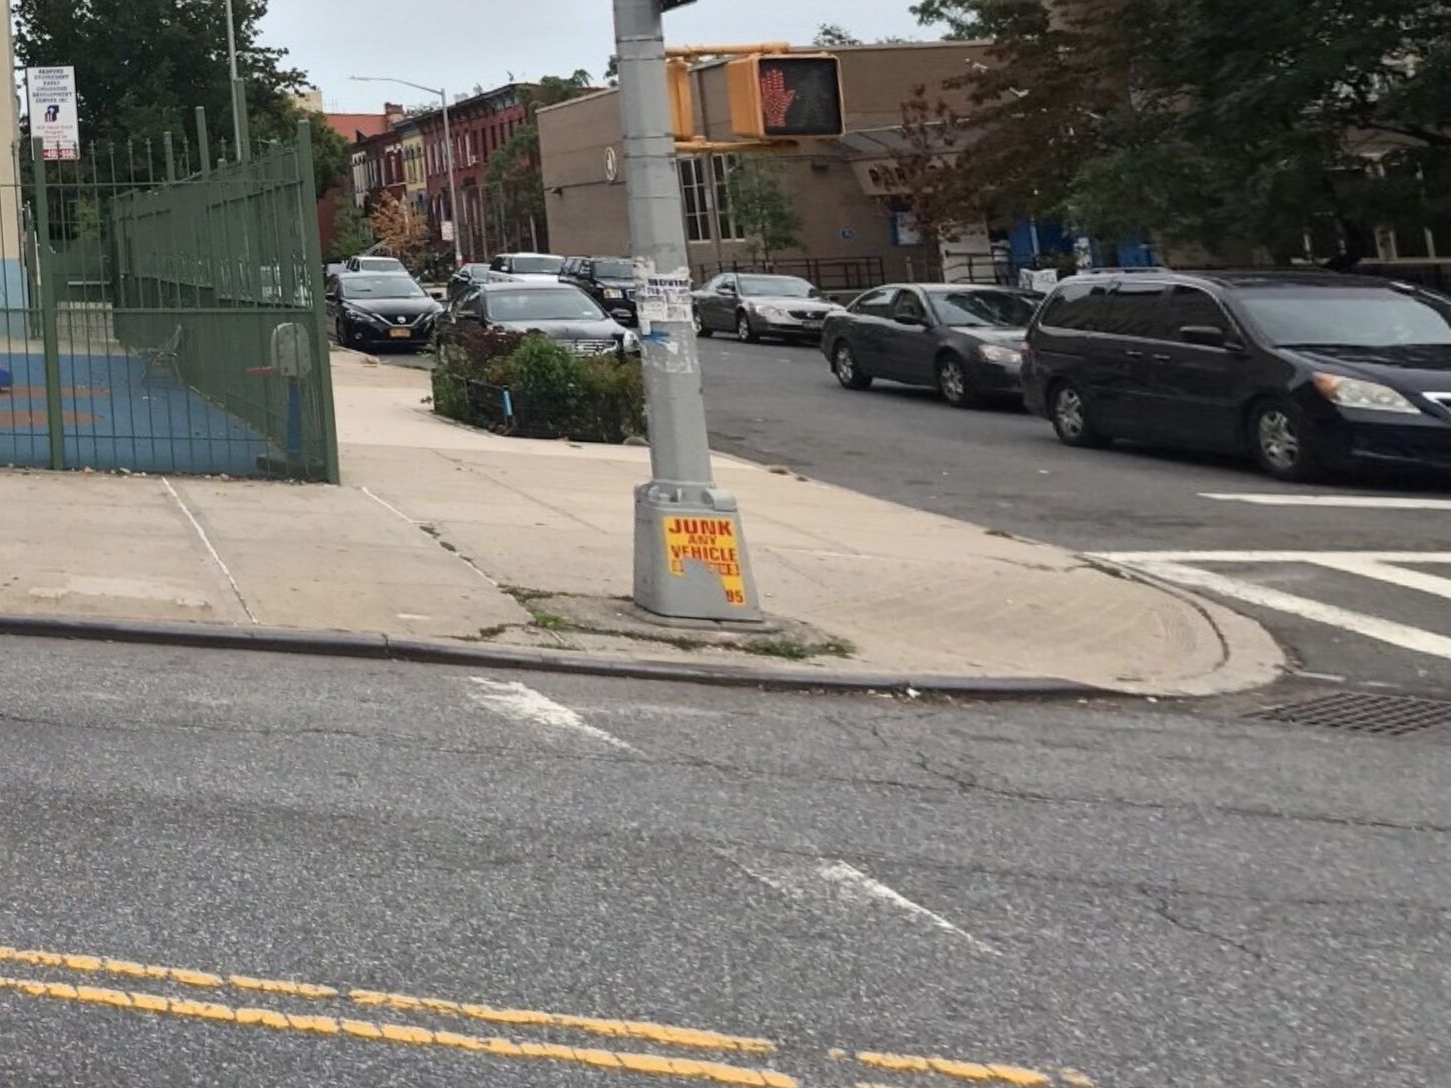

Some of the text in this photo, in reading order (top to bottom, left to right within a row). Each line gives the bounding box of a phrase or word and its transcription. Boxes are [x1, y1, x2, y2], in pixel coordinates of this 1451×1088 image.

[669, 519, 732, 535] JUNK
[688, 536, 717, 545] ANY
[671, 545, 738, 561] VEHICLE
